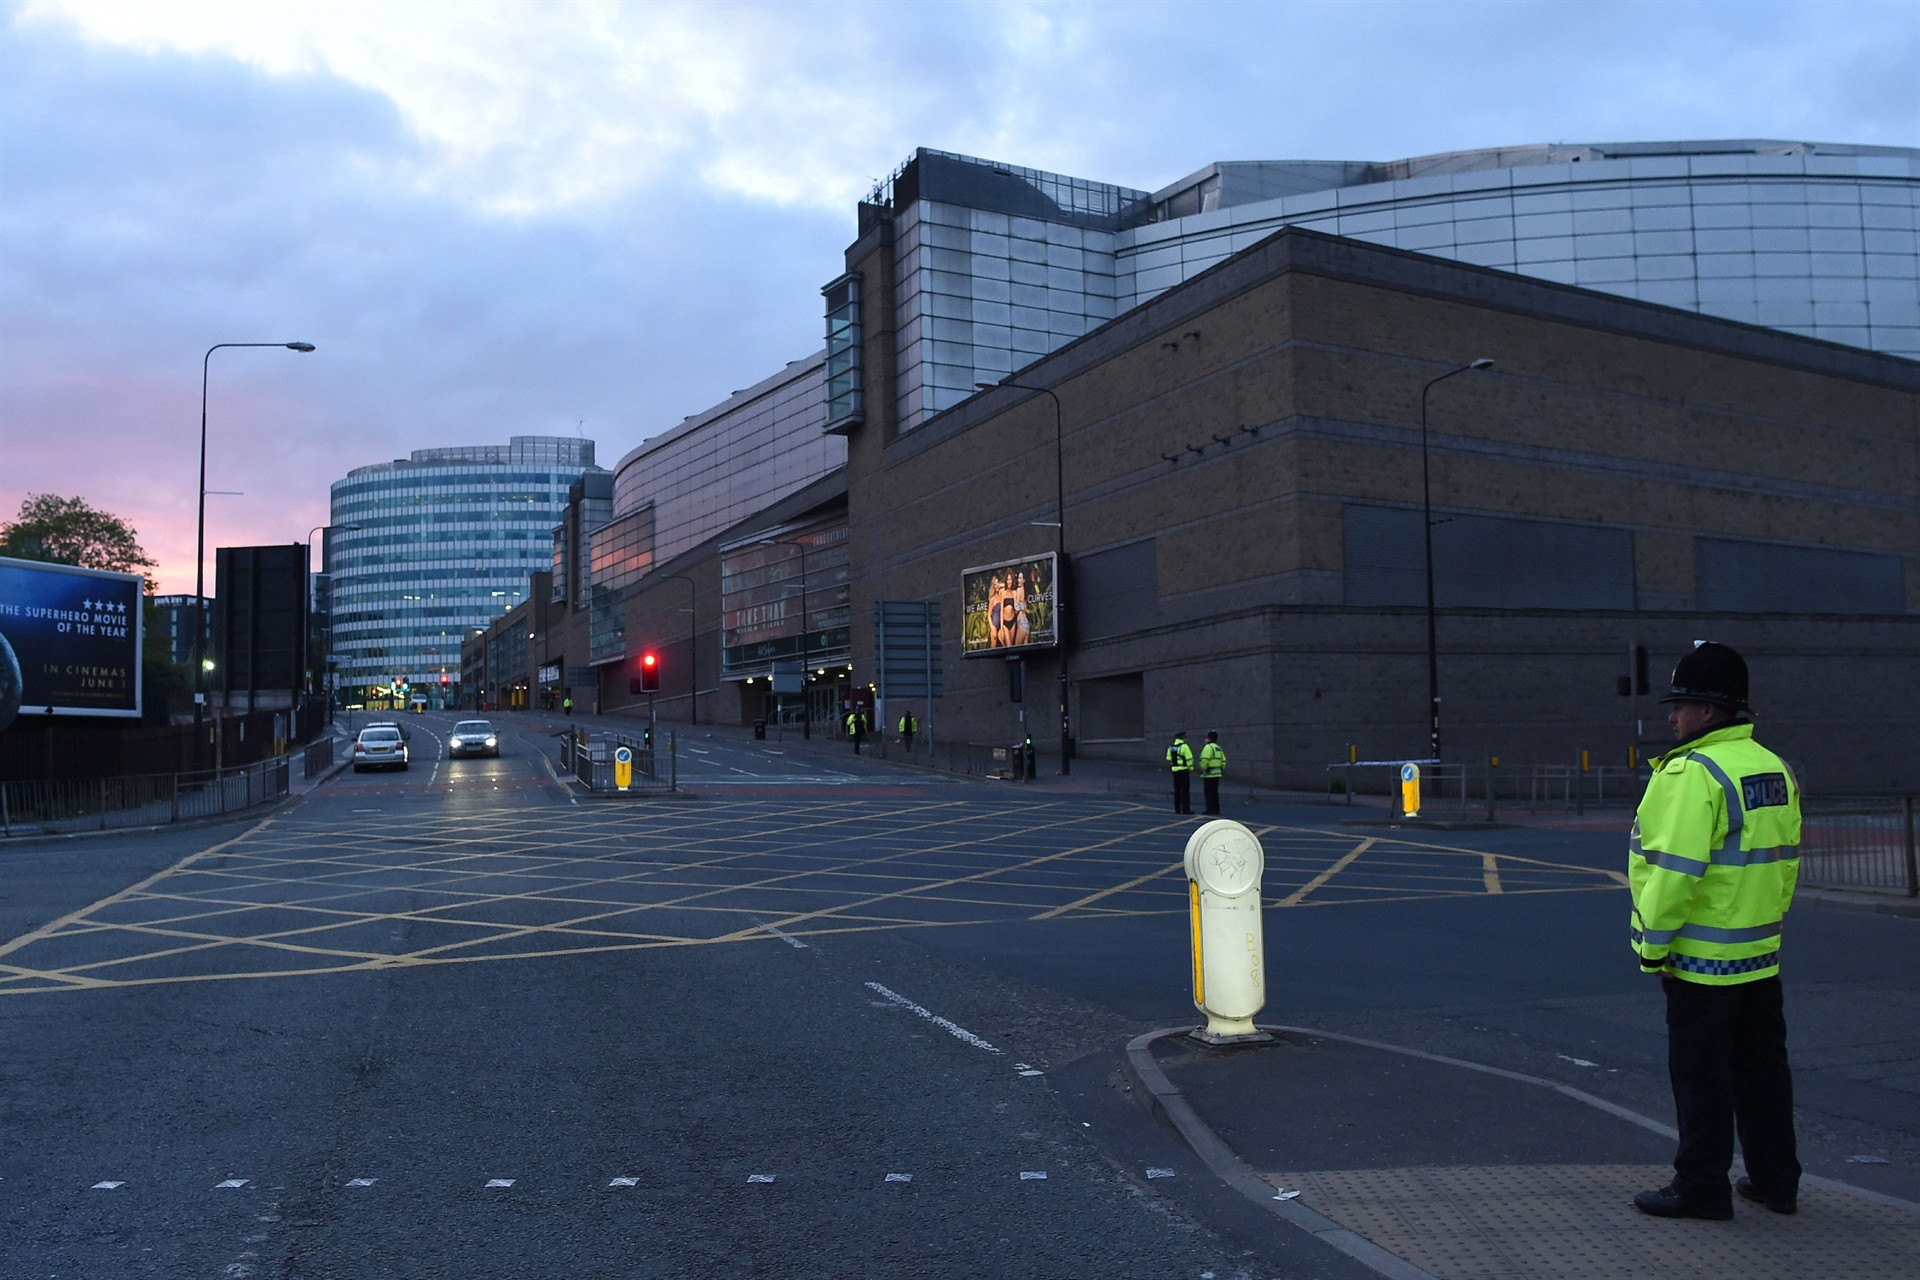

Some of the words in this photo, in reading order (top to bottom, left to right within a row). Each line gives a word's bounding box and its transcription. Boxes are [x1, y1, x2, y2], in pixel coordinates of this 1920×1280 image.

[1027, 591, 1053, 604] CURVES
[976, 601, 989, 612] ARE
[0, 604, 20, 616] THE
[25, 607, 89, 622] SUPERHERO
[94, 613, 127, 626] MOVIE
[57, 622, 72, 633] OF
[77, 624, 96, 635] THE
[43, 664, 58, 673] IN
[66, 665, 126, 678] CINEMAS
[80, 678, 114, 689] JUNE
[1743, 781, 1787, 809] POLICE
